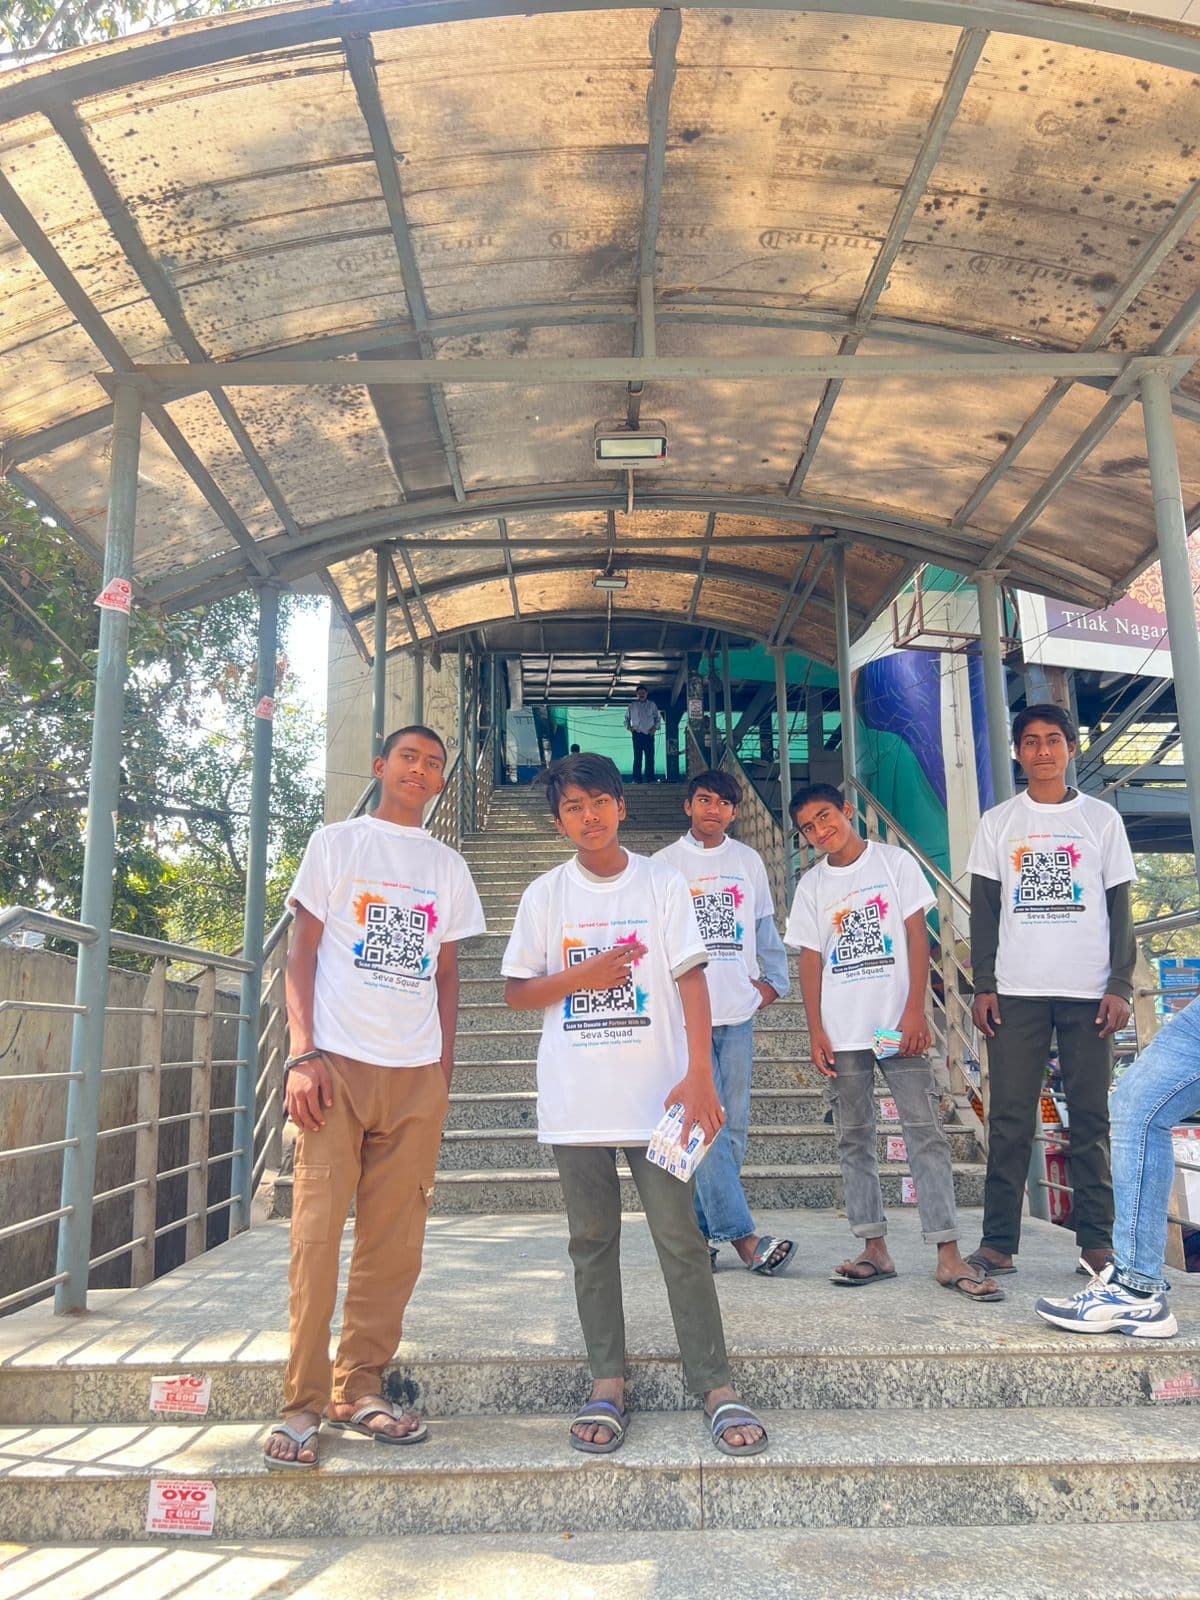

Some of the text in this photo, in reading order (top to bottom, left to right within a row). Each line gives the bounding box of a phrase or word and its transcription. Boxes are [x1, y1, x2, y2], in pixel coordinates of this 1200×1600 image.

[1062, 611, 1168, 641] Tilak Nagar
[371, 972, 394, 984] Seva
[395, 977, 421, 989] Squad
[580, 1028, 633, 1040] Seva Squad
[162, 1489, 207, 1501] OYO
